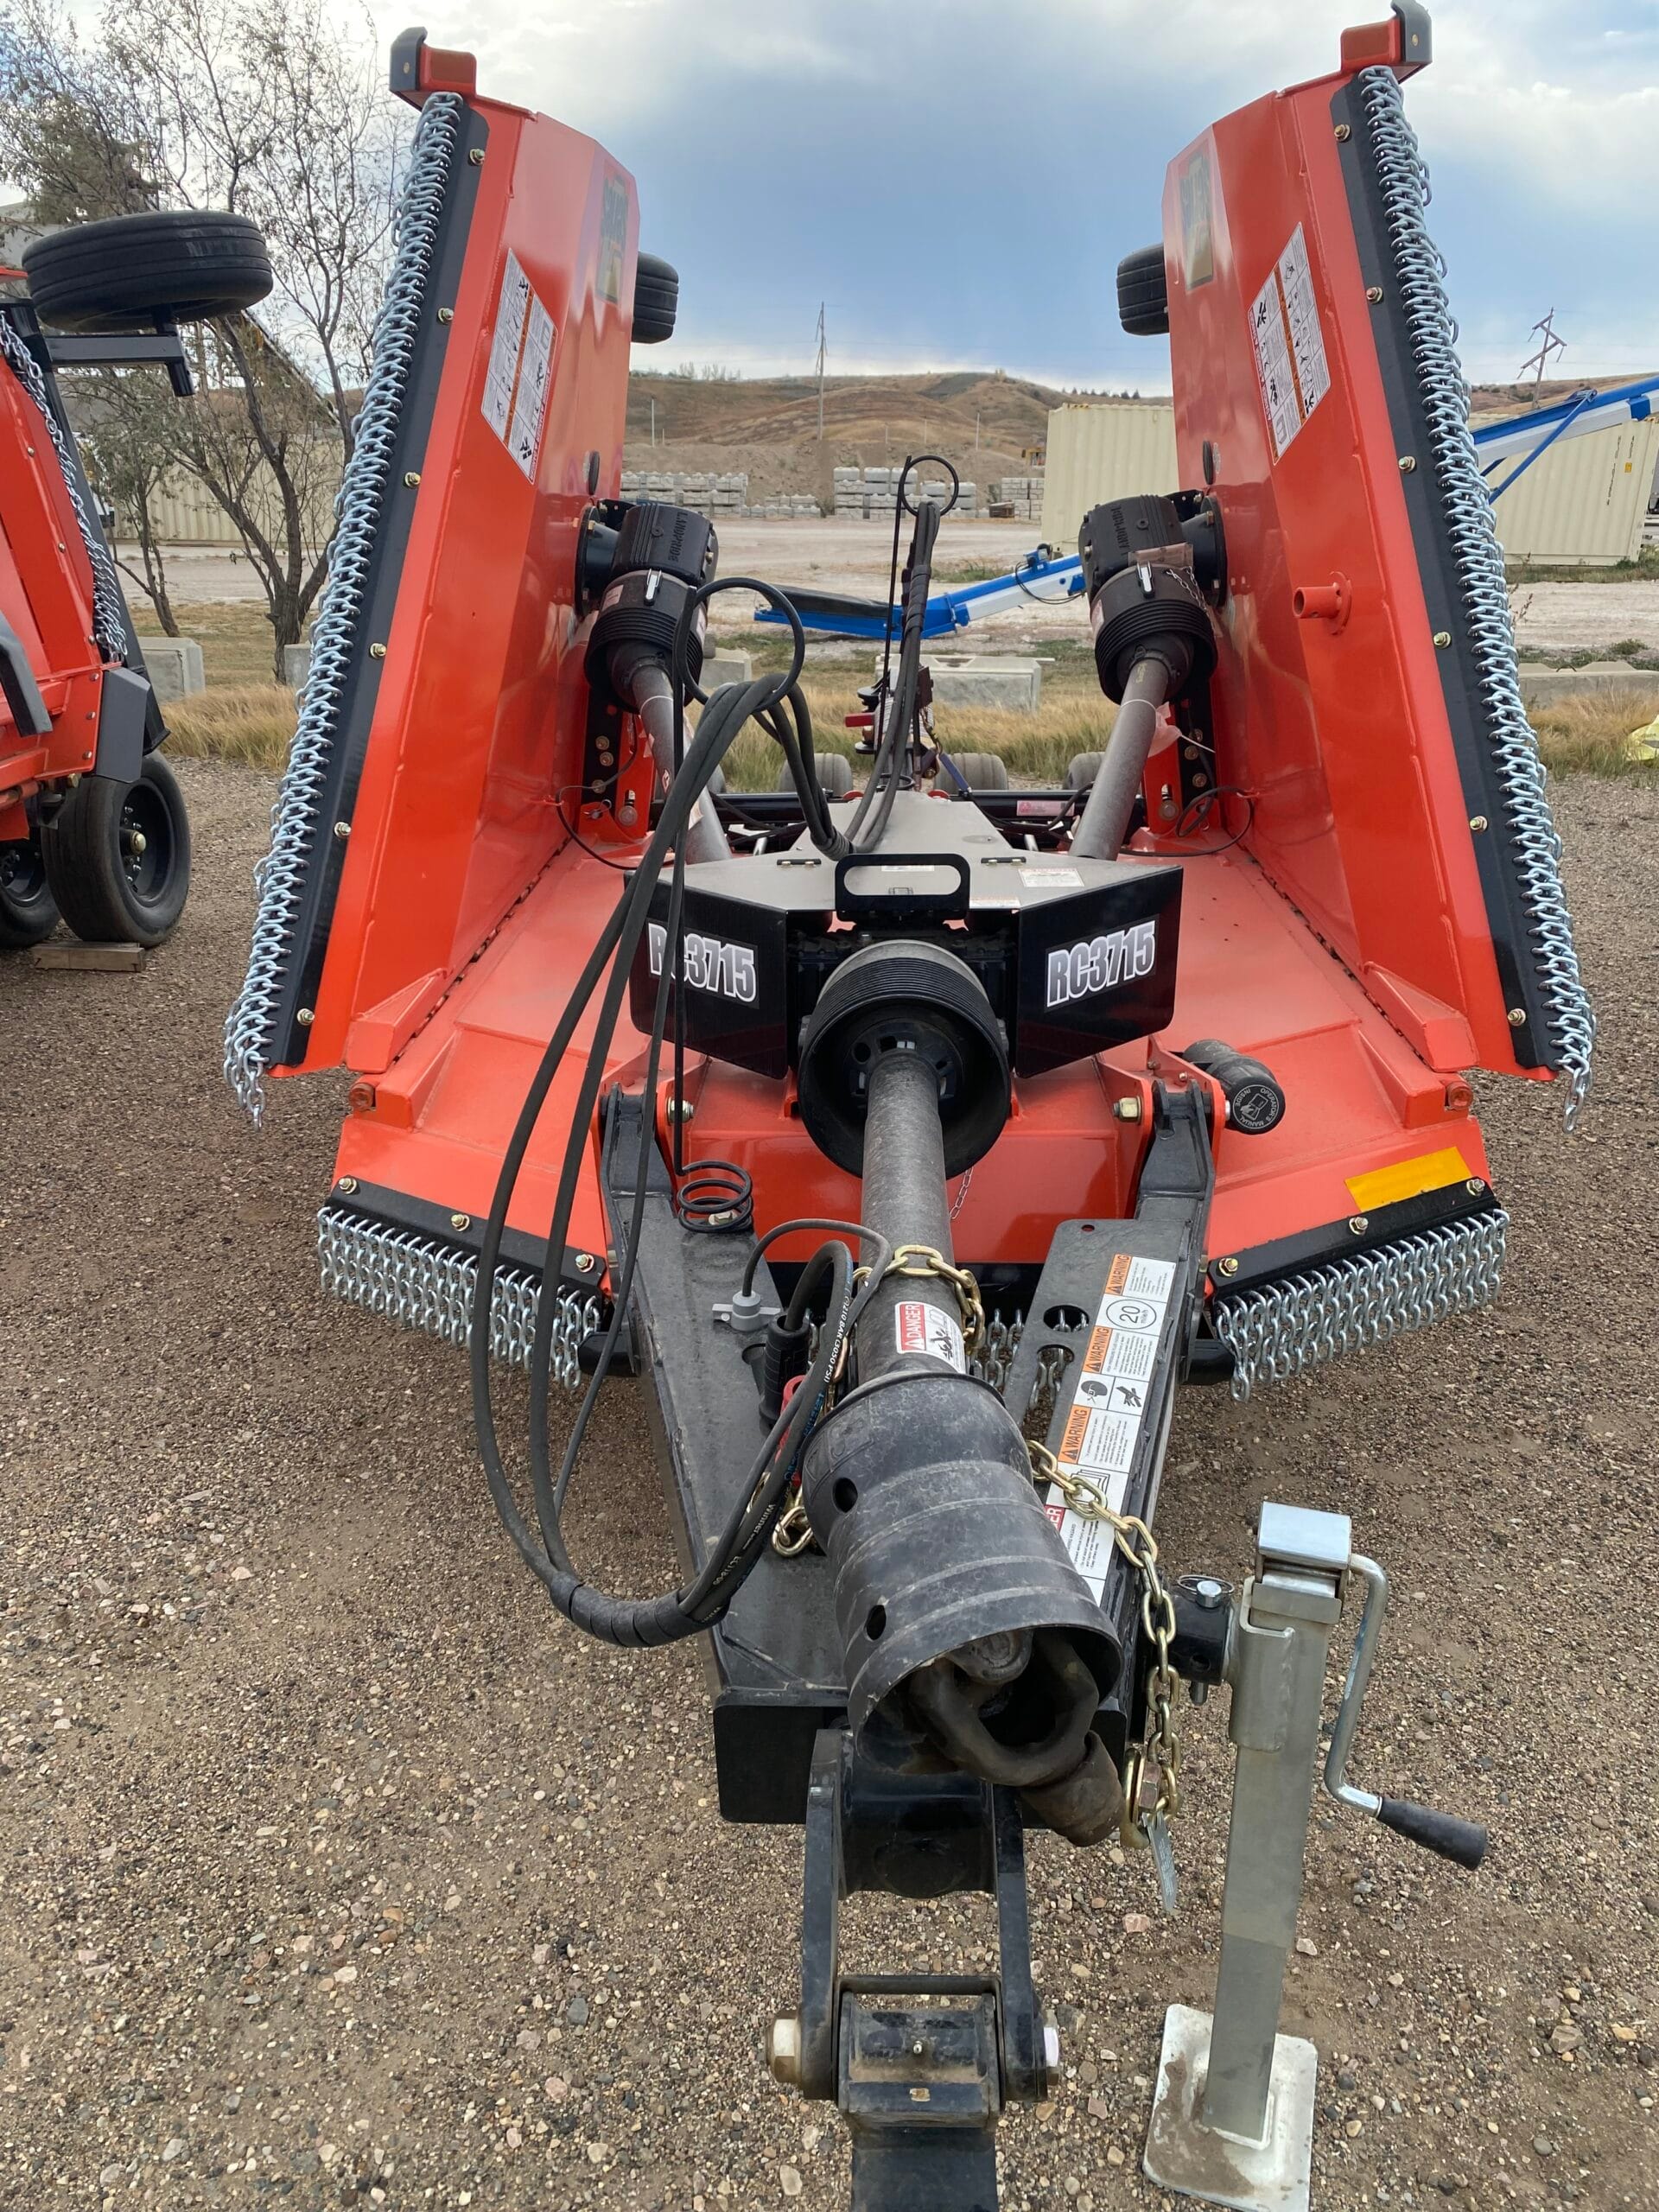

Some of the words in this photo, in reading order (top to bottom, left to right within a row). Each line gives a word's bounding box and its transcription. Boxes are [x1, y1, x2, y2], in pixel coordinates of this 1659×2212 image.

[1047, 920, 1155, 1007] RC3715
[1236, 1088, 1251, 1107] INSIDE
[1240, 1115, 1264, 1127] MANUAL
[1110, 1255, 1130, 1285] WARNING
[905, 1305, 923, 1338] DANGER
[1120, 1306, 1141, 1324] 20
[836, 1320, 846, 1339] BAR
[830, 1339, 842, 1365] (3050
[1090, 1327, 1110, 1361] WARNING
[823, 1364, 834, 1383] PSI)
[1065, 1408, 1088, 1448] WARNING
[753, 1503, 776, 1534] Winner
